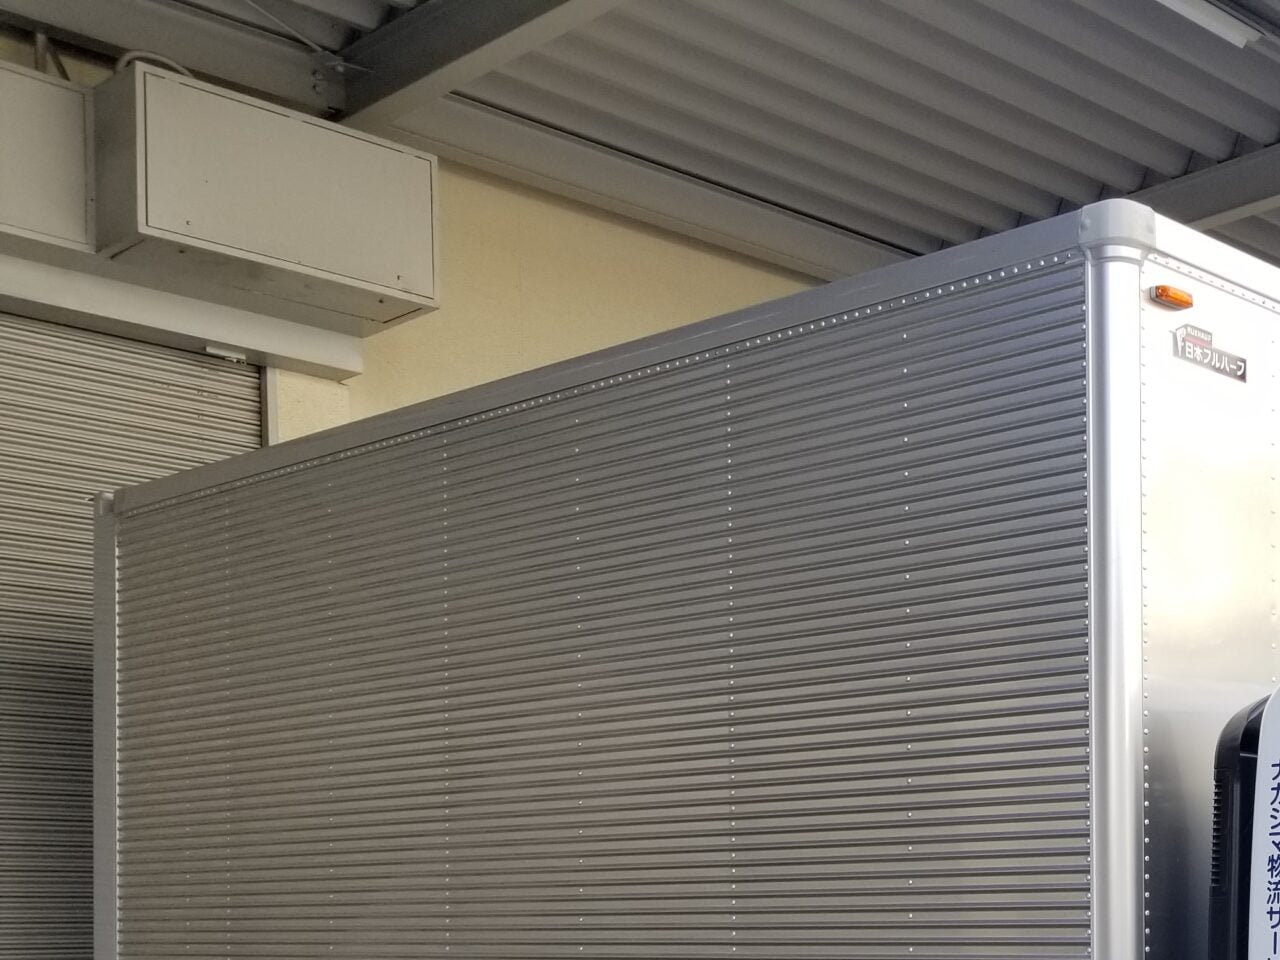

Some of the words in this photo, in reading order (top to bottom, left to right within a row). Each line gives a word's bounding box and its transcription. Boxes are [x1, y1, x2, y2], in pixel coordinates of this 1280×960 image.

[1185, 342, 1245, 376] 日本フルハーフ
